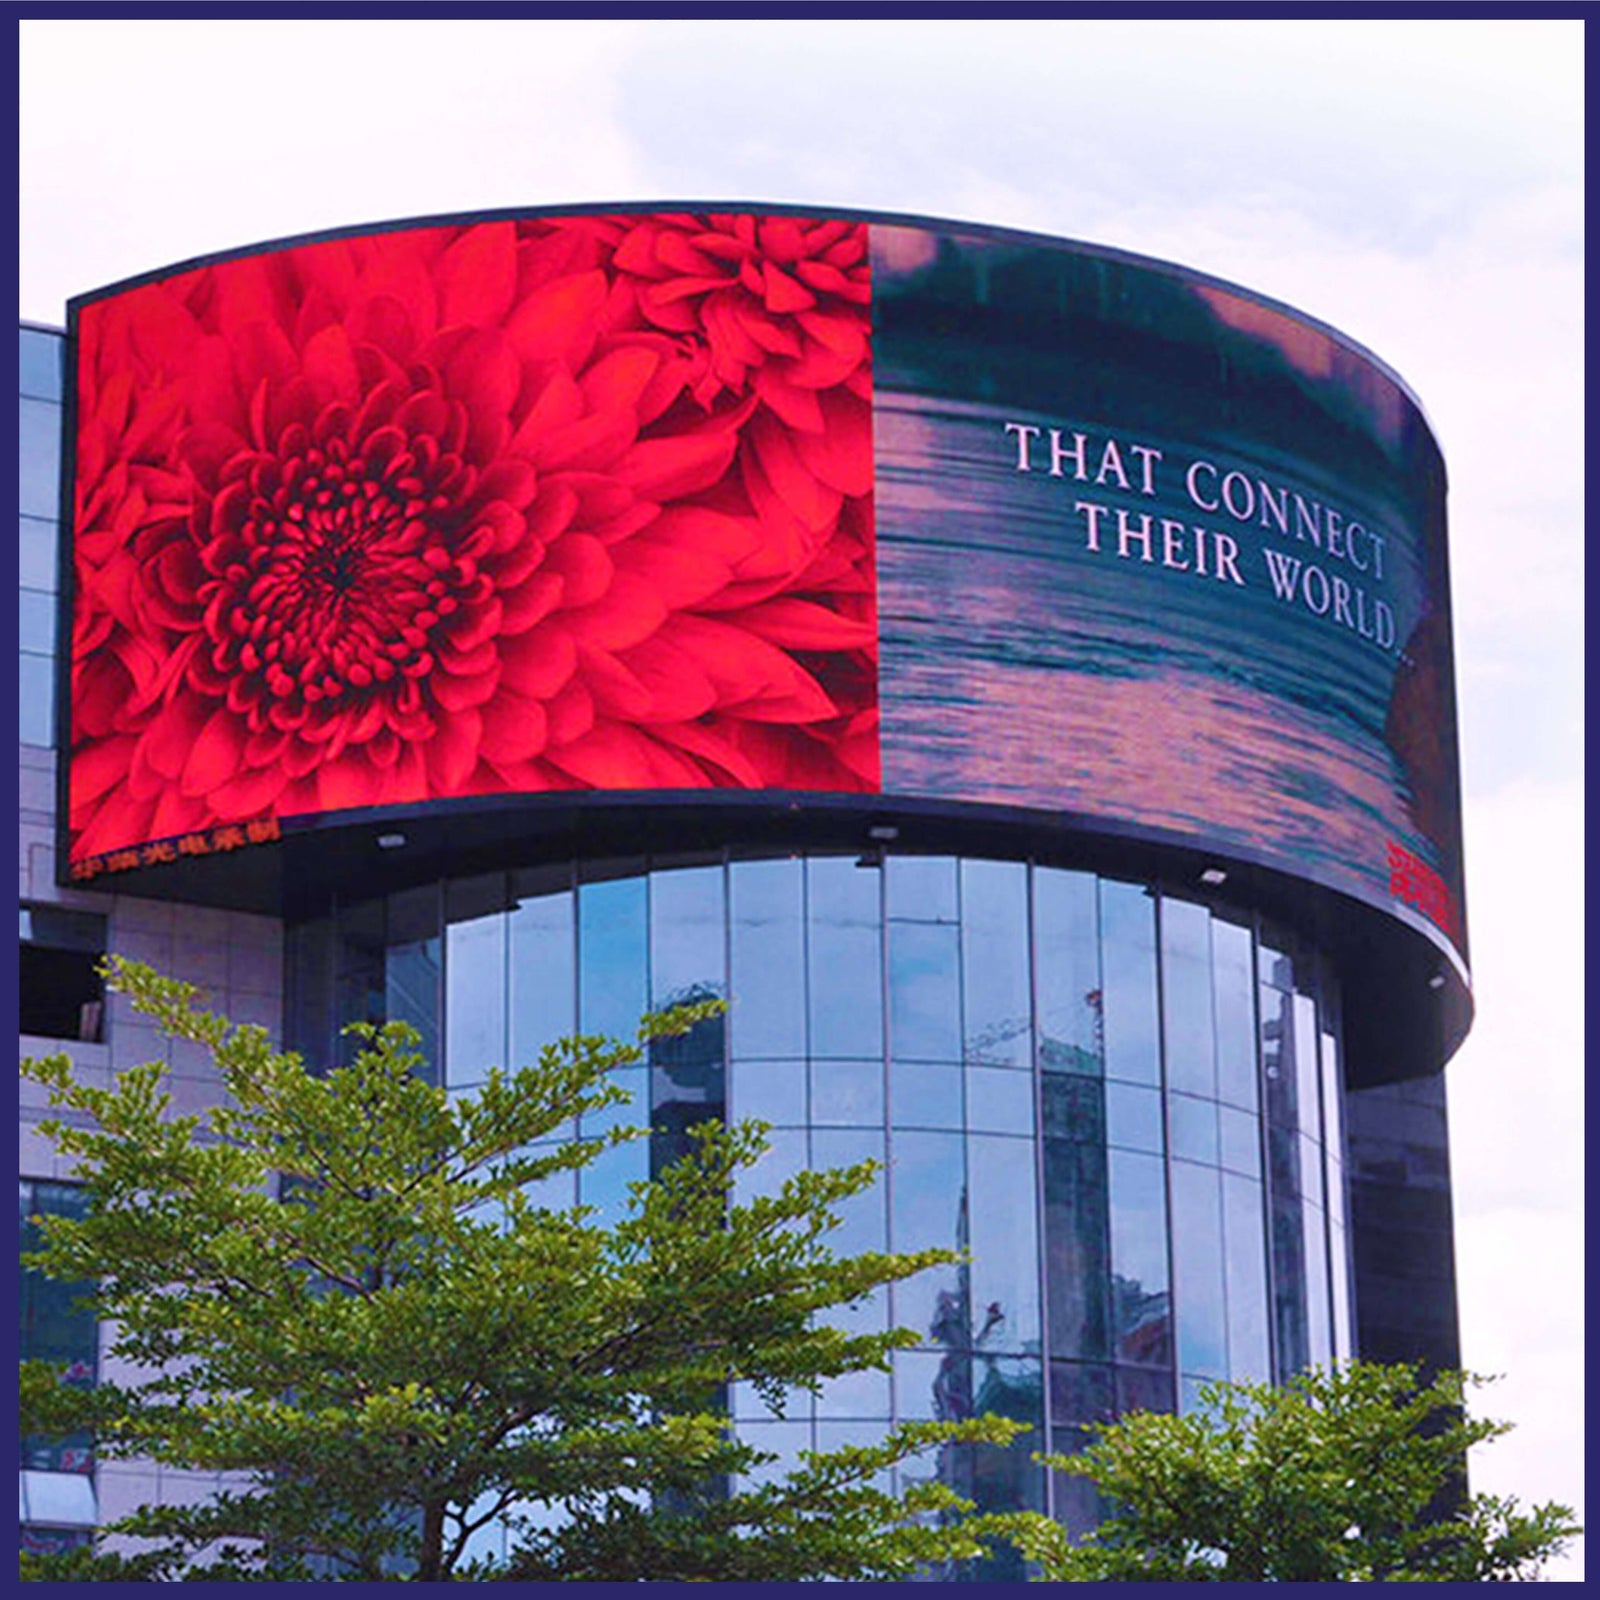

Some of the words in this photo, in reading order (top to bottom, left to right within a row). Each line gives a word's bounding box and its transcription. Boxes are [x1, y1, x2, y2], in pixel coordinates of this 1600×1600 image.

[1005, 422, 1163, 495] THAT
[1187, 461, 1387, 580] CONNECT
[1075, 501, 1246, 586] THEIR
